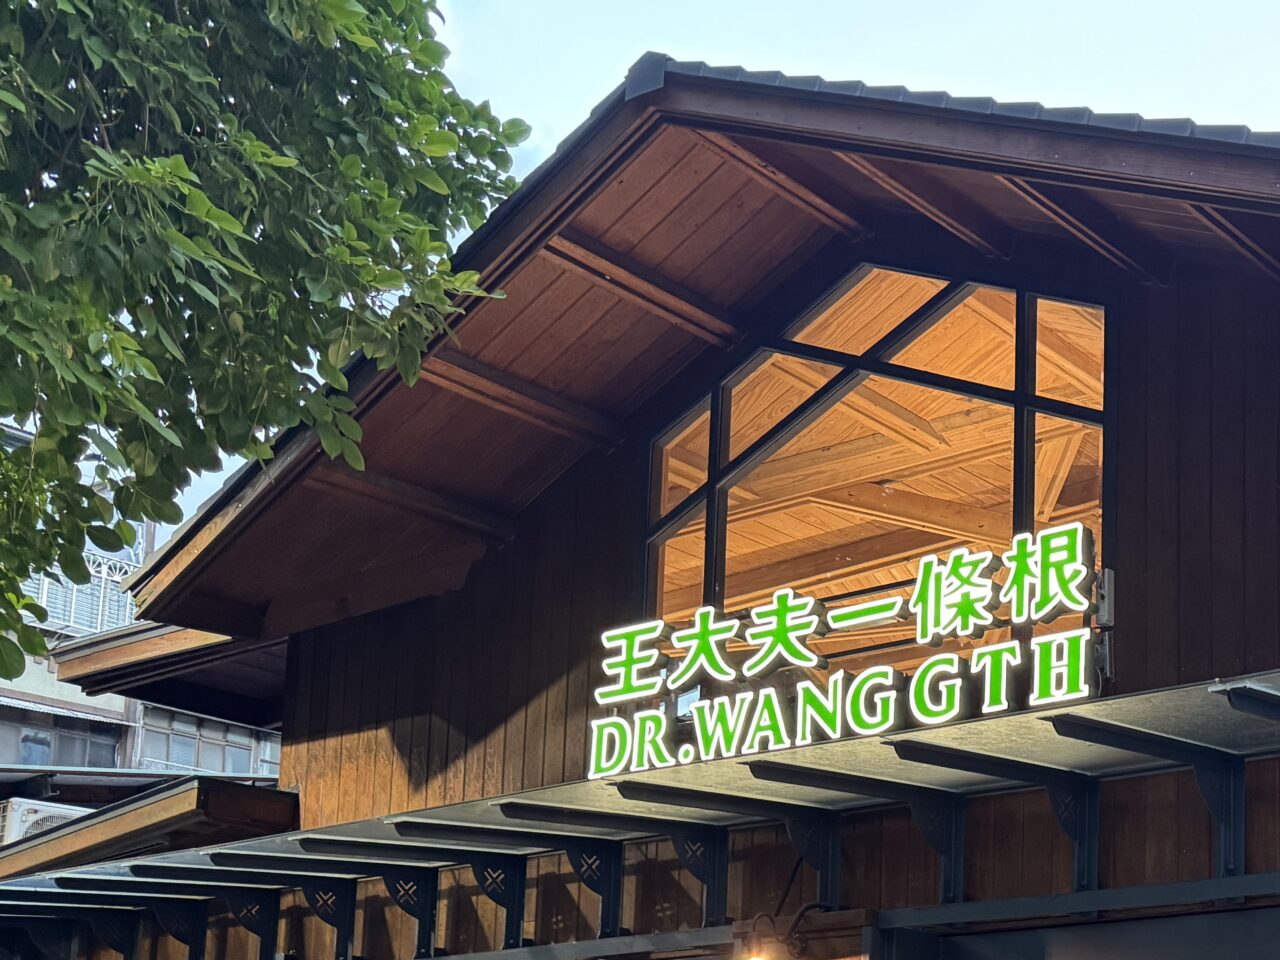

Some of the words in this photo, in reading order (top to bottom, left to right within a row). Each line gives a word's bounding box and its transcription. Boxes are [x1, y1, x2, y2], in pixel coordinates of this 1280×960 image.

[594, 521, 1089, 705] 王大夫一條根
